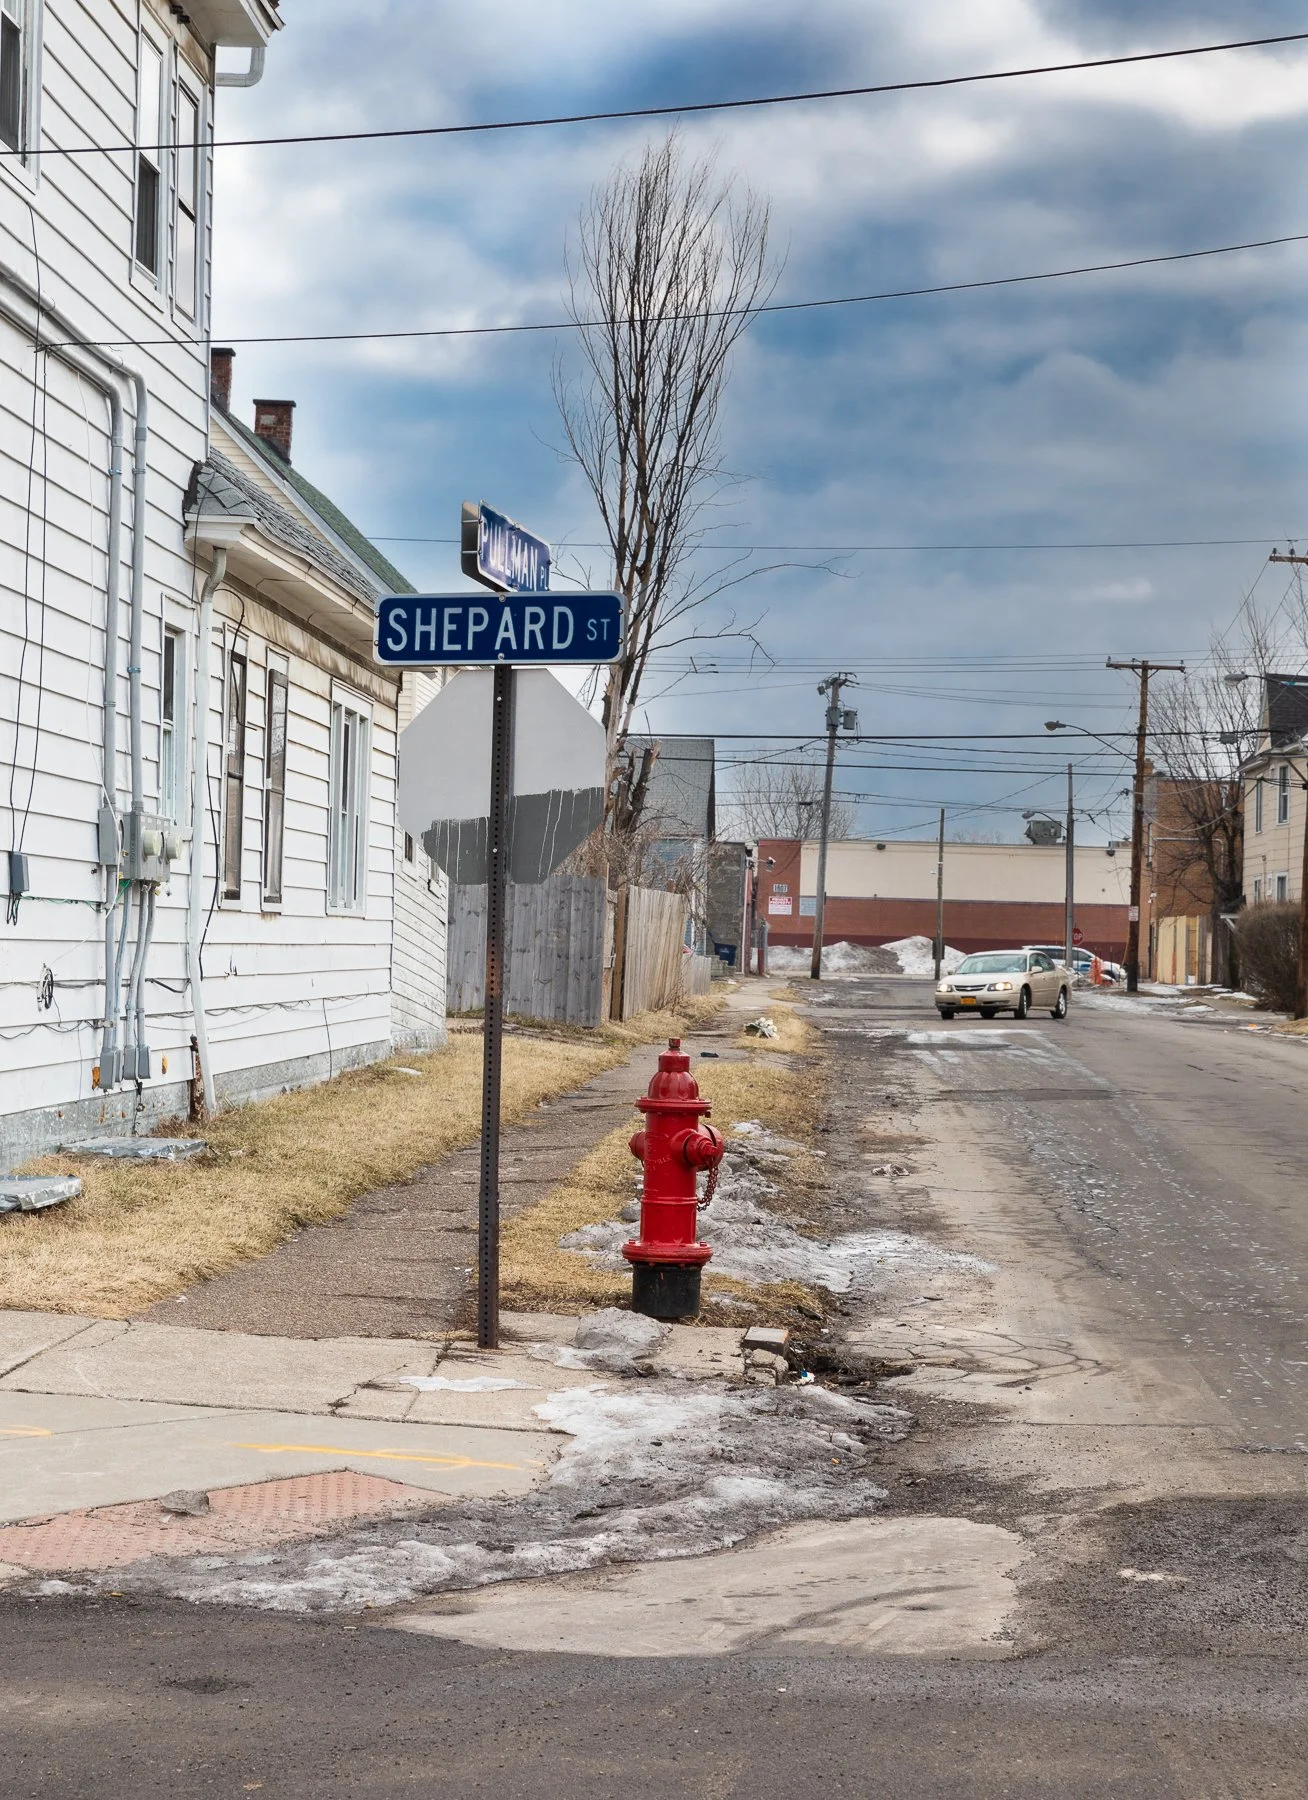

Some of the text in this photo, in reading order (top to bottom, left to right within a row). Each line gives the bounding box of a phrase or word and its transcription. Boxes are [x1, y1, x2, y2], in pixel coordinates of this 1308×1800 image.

[480, 514, 548, 591] PULLMAN PL
[386, 606, 611, 651] SHEPARD ST
